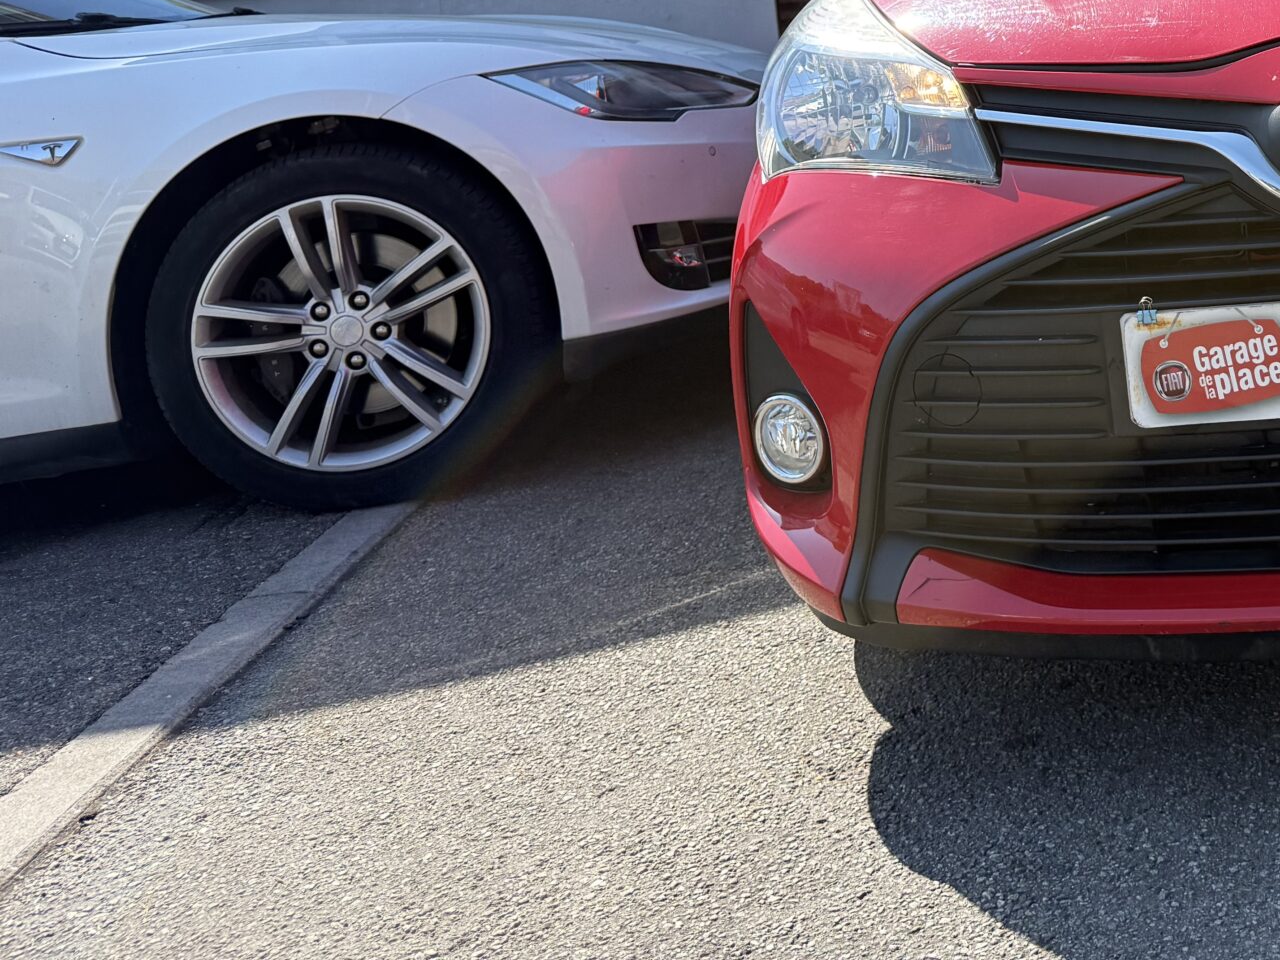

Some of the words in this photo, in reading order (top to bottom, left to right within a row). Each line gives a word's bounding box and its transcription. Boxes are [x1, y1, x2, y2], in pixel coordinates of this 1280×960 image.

[1193, 334, 1279, 373] Garage
[1161, 371, 1184, 393] FIAT
[1199, 373, 1212, 387] de
[1205, 386, 1216, 400] la
